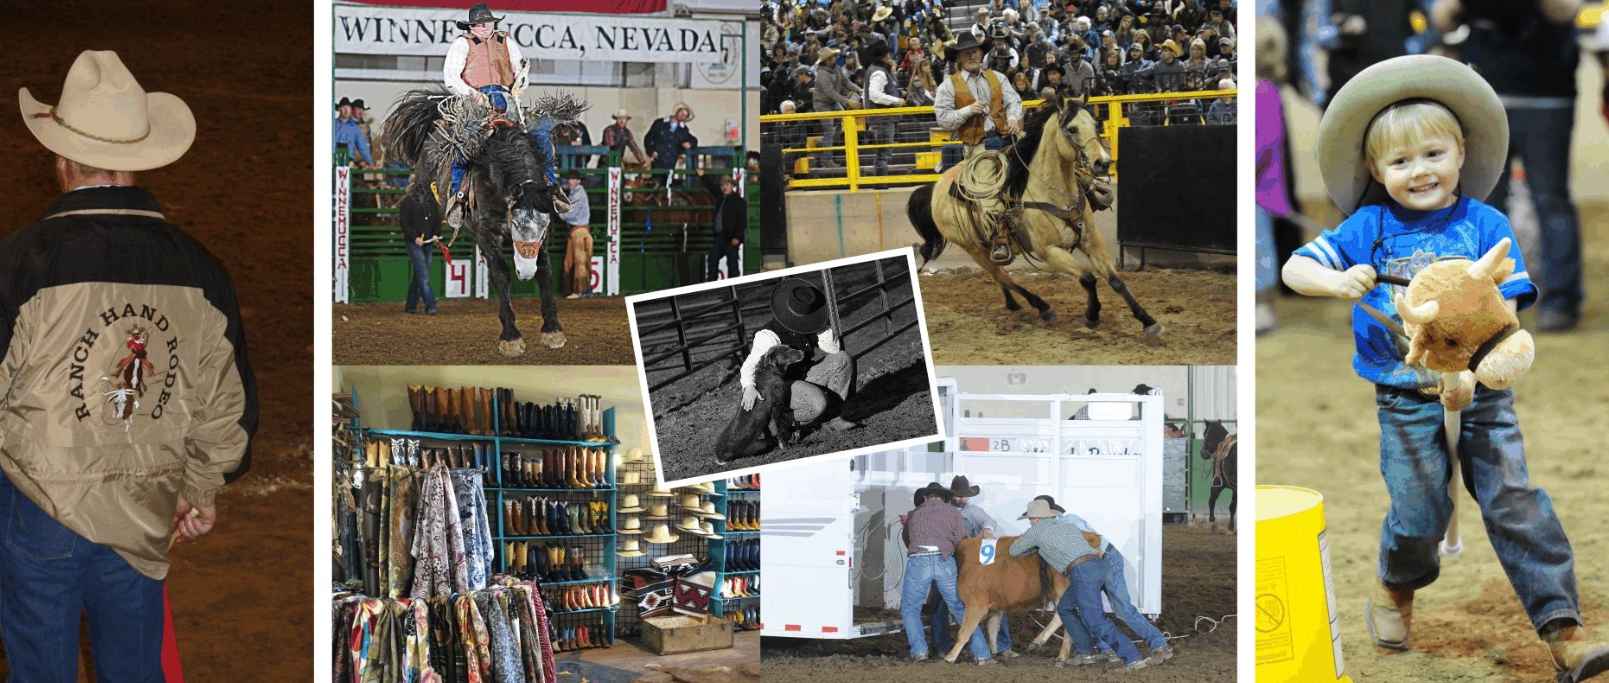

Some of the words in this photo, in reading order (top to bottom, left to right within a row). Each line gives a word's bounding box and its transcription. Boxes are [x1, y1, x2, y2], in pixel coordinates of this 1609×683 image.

[595, 25, 718, 53] NEVADA
[337, 169, 348, 270] WINNEMUCCA
[609, 170, 620, 265] WINNEMUCA
[451, 264, 466, 295] 4
[69, 327, 99, 422] RANCH
[100, 302, 169, 333] HAND
[151, 336, 179, 420] RODEO
[980, 543, 995, 564] 9
